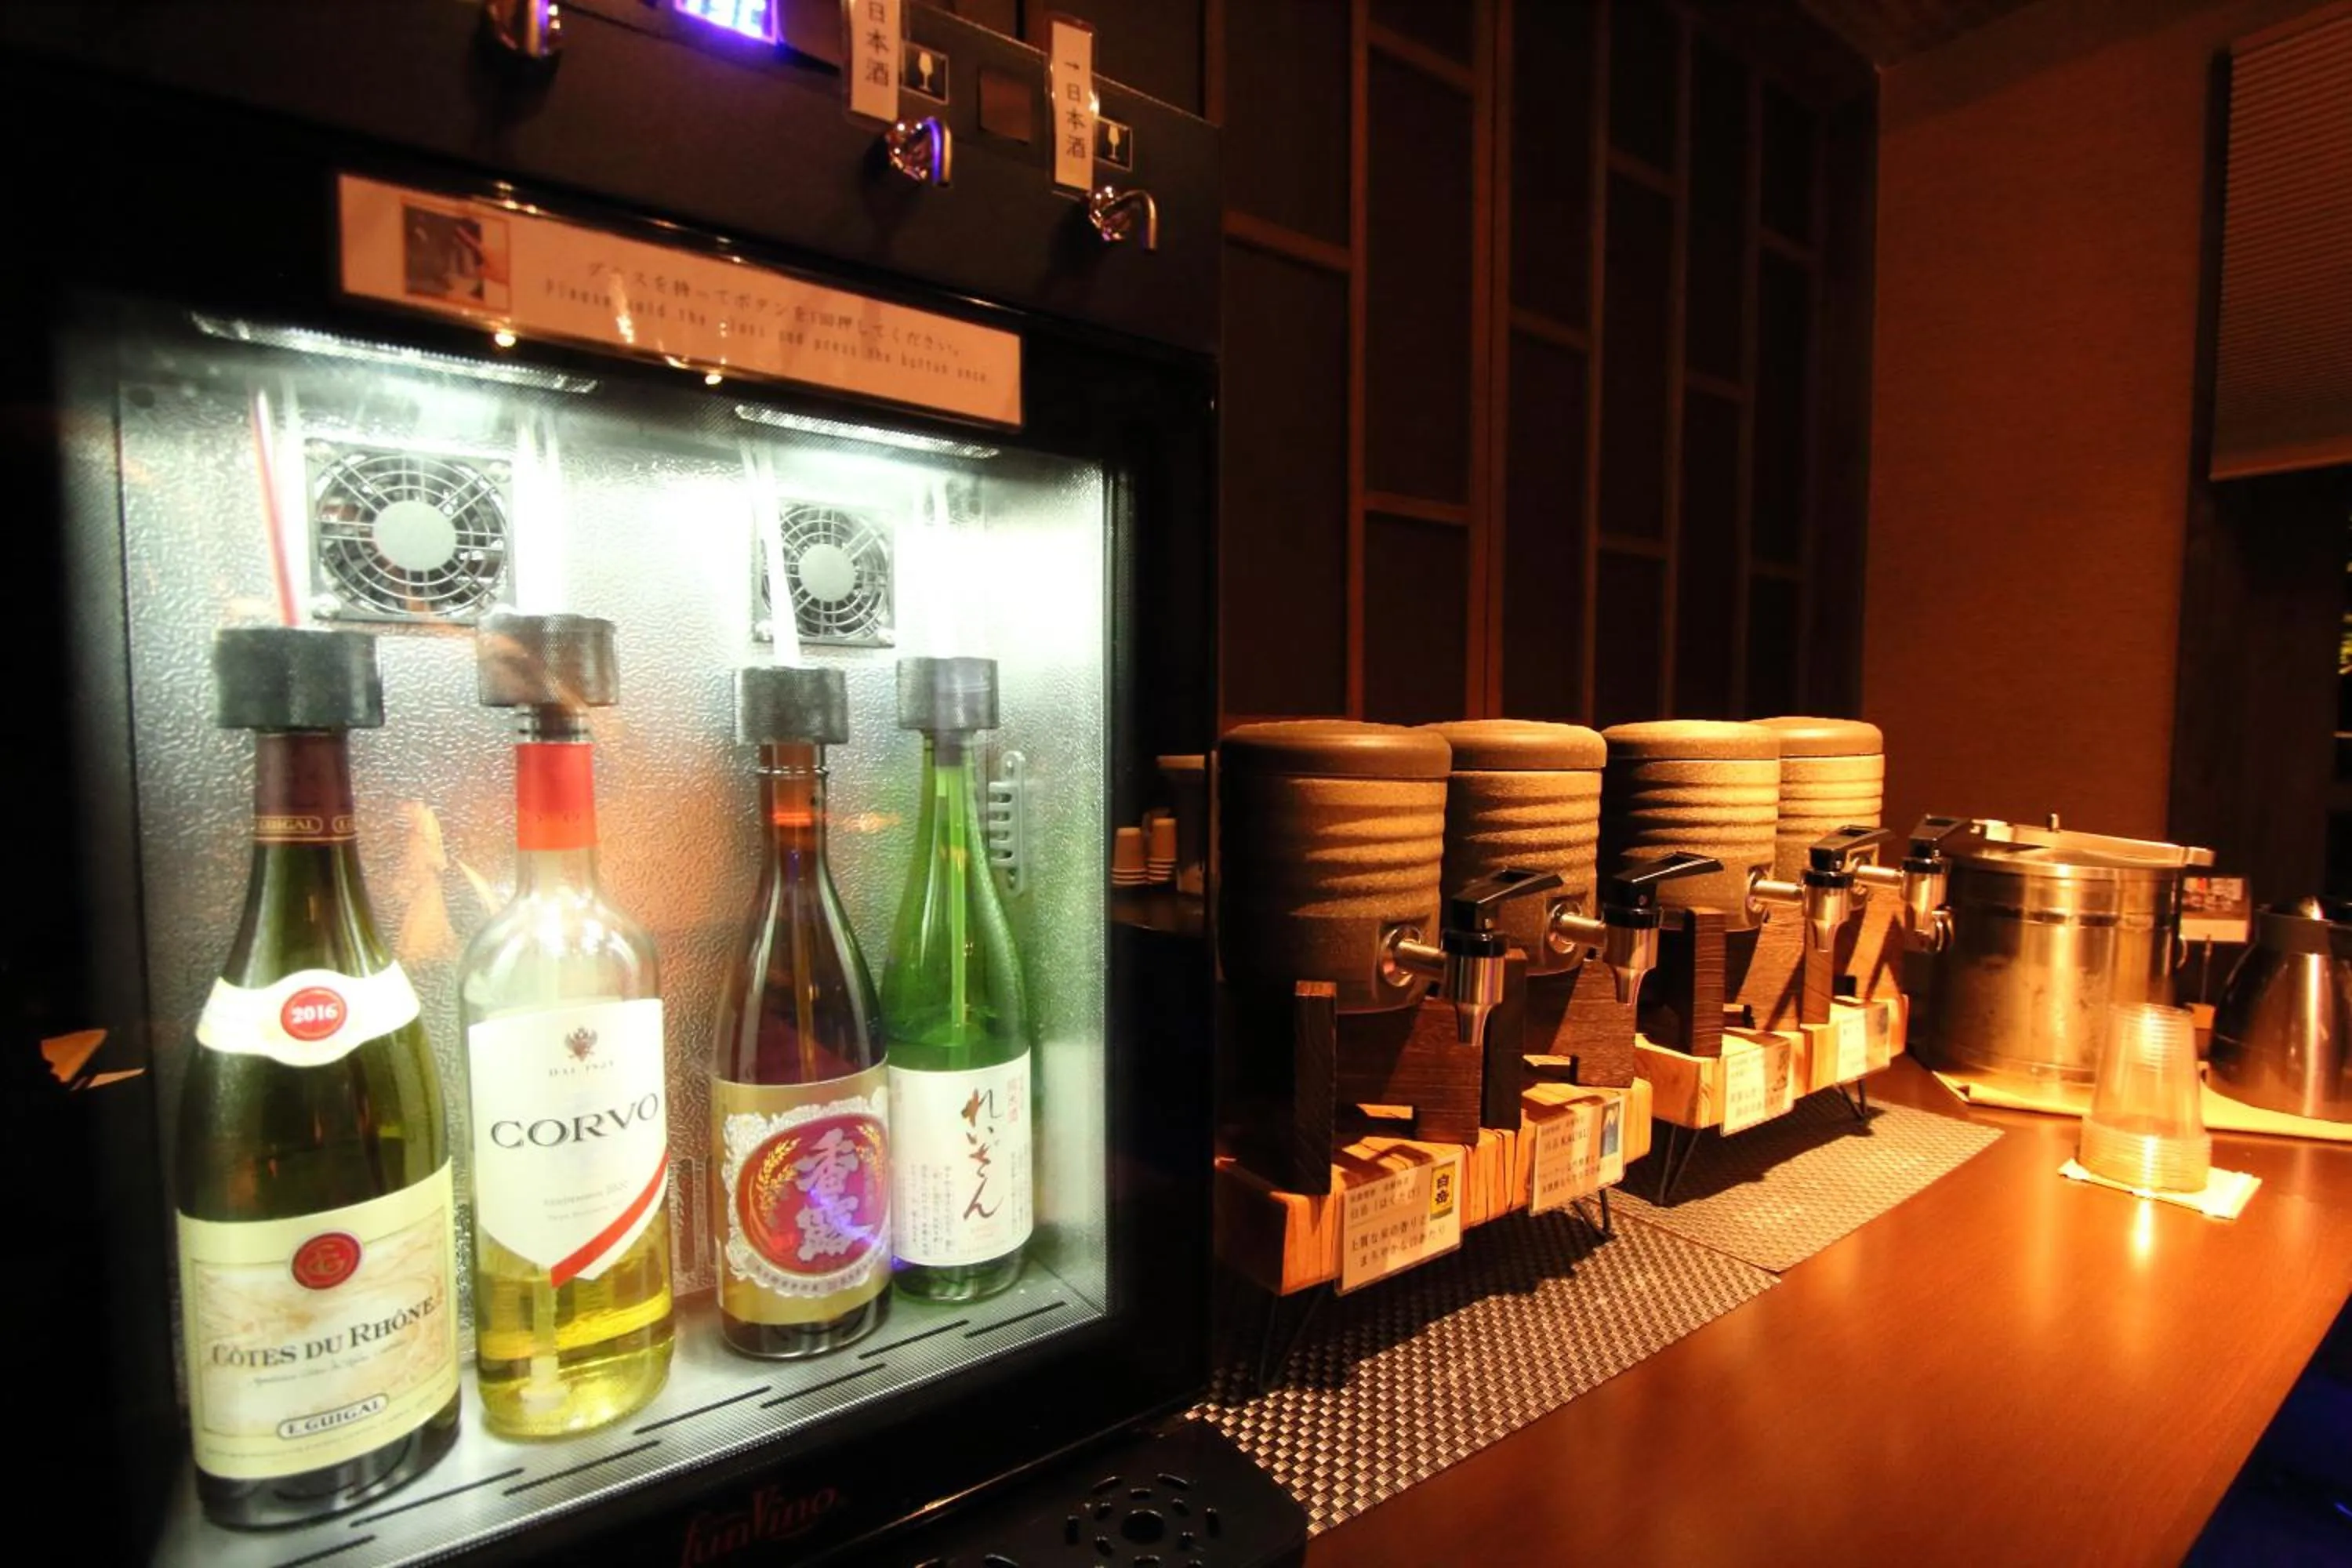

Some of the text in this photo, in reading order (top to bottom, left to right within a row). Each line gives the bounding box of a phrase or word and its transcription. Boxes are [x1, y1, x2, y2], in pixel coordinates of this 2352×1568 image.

[866, 1, 889, 88] 日本酒
[1066, 82, 1085, 159] 日本酒
[719, 315, 765, 338] lass
[292, 1004, 338, 1025] 2016
[491, 1092, 659, 1149] CORVO
[305, 1334, 344, 1359] DU
[350, 1296, 434, 1348] RHÔNE
